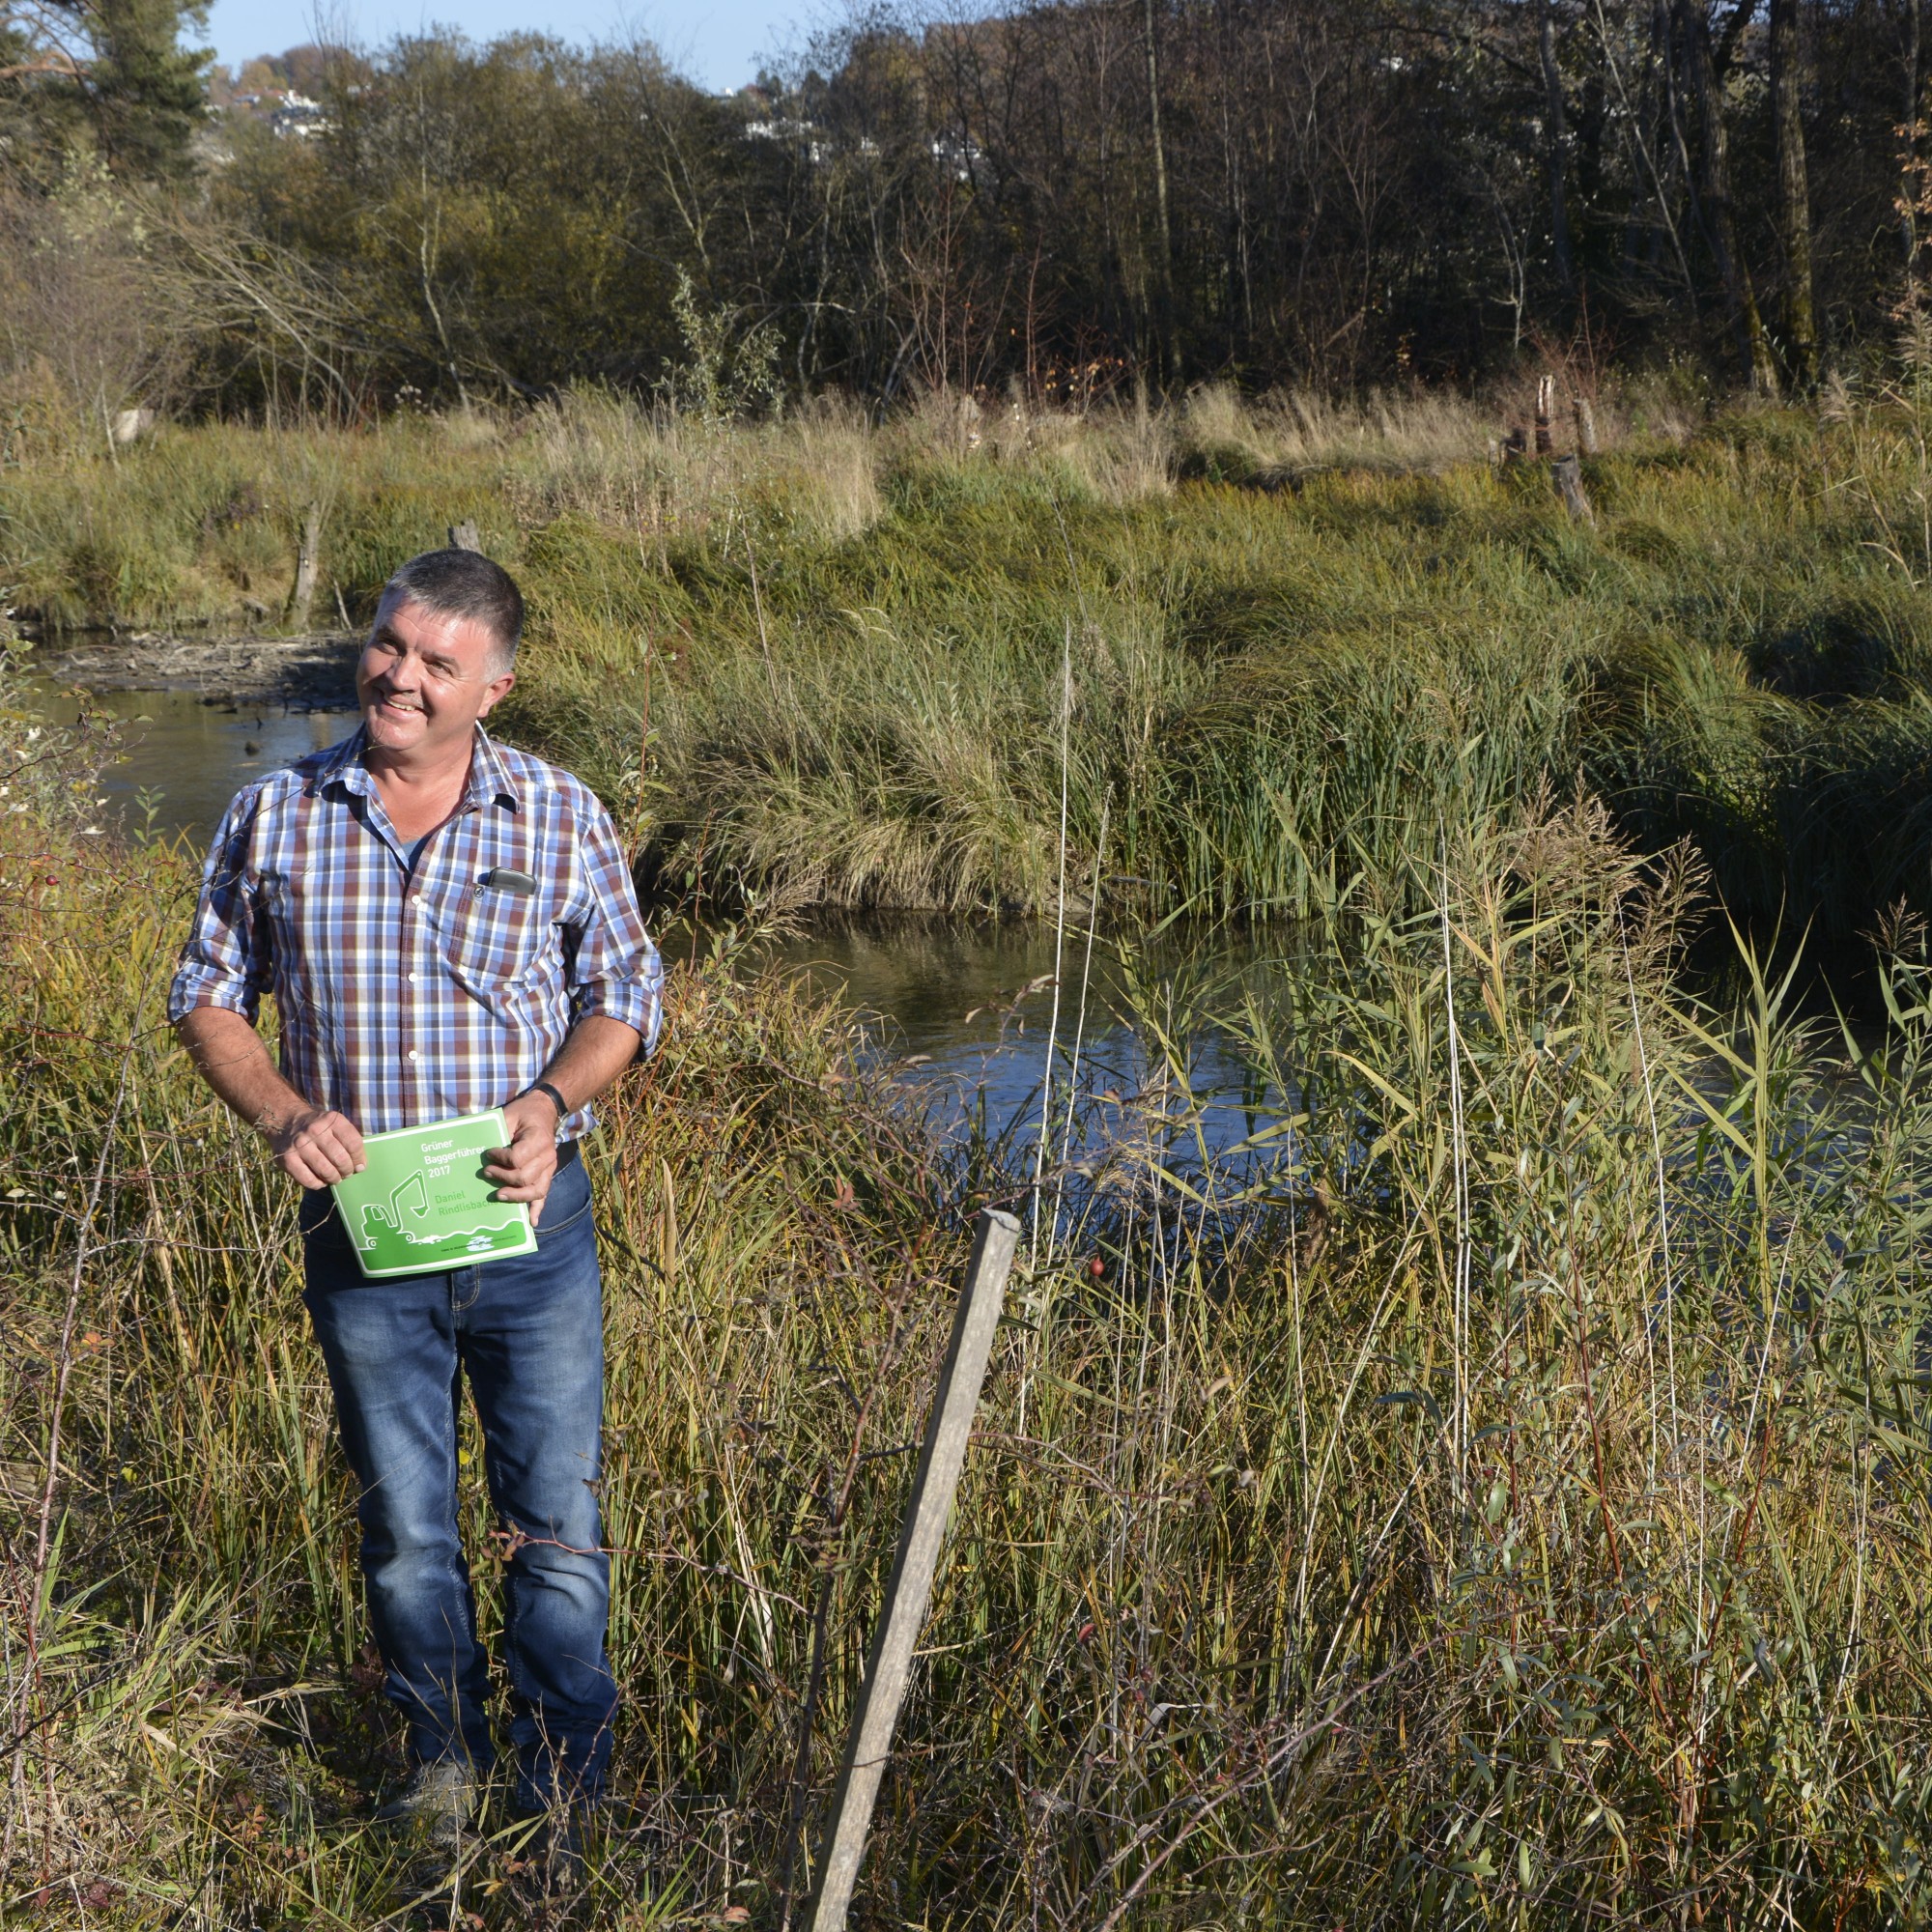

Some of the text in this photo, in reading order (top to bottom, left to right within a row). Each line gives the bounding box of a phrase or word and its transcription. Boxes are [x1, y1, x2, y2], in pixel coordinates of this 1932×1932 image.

[421, 1140, 454, 1152] Grüner
[425, 1146, 486, 1165] Baggerführer
[428, 1165, 450, 1178] 2017
[435, 1190, 466, 1205] Daniel
[439, 1199, 502, 1216] Rindlisbac
